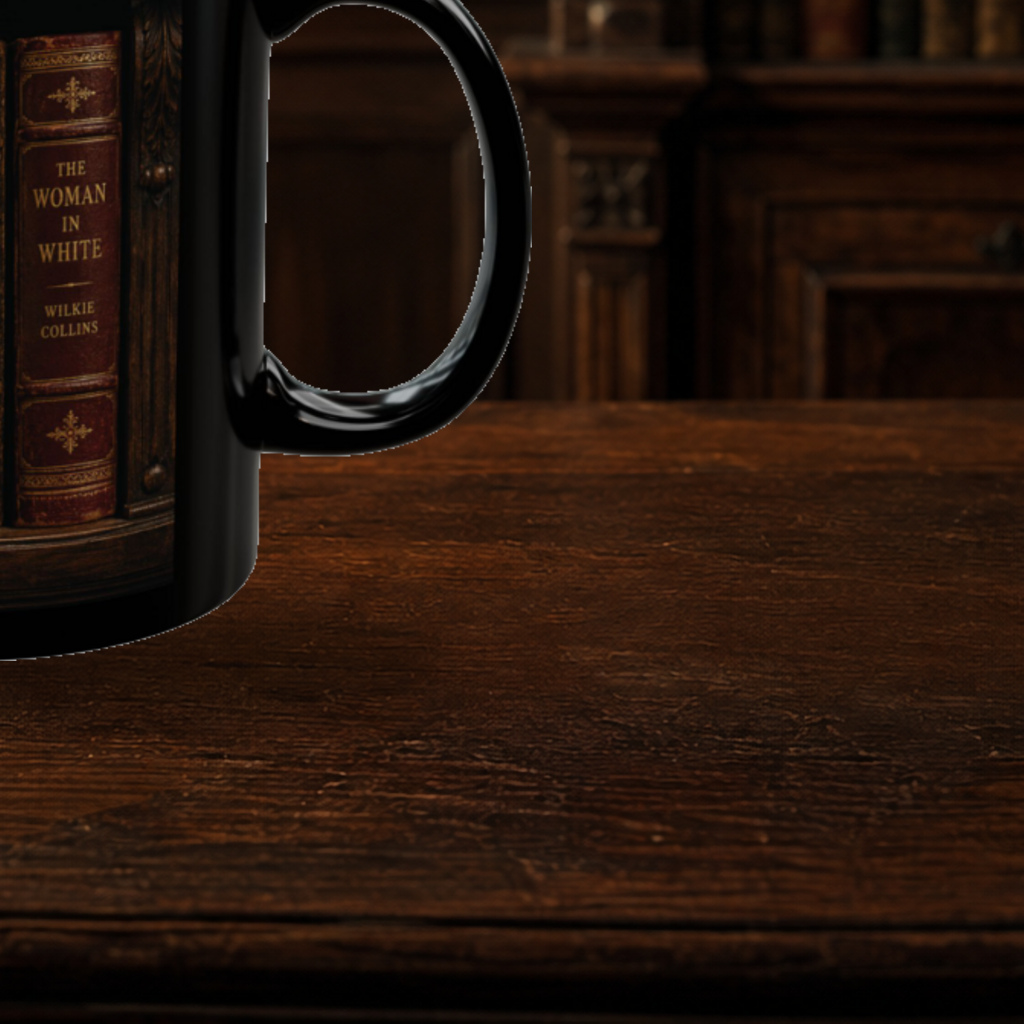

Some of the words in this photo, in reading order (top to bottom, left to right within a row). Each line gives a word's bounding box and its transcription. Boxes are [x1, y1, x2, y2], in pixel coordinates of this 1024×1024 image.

[55, 160, 87, 178] THE
[32, 182, 107, 209] WOMAN
[61, 214, 81, 233] IN
[37, 237, 103, 263] WHITE
[44, 300, 96, 318] WILKIE
[40, 320, 99, 339] COLLINS
